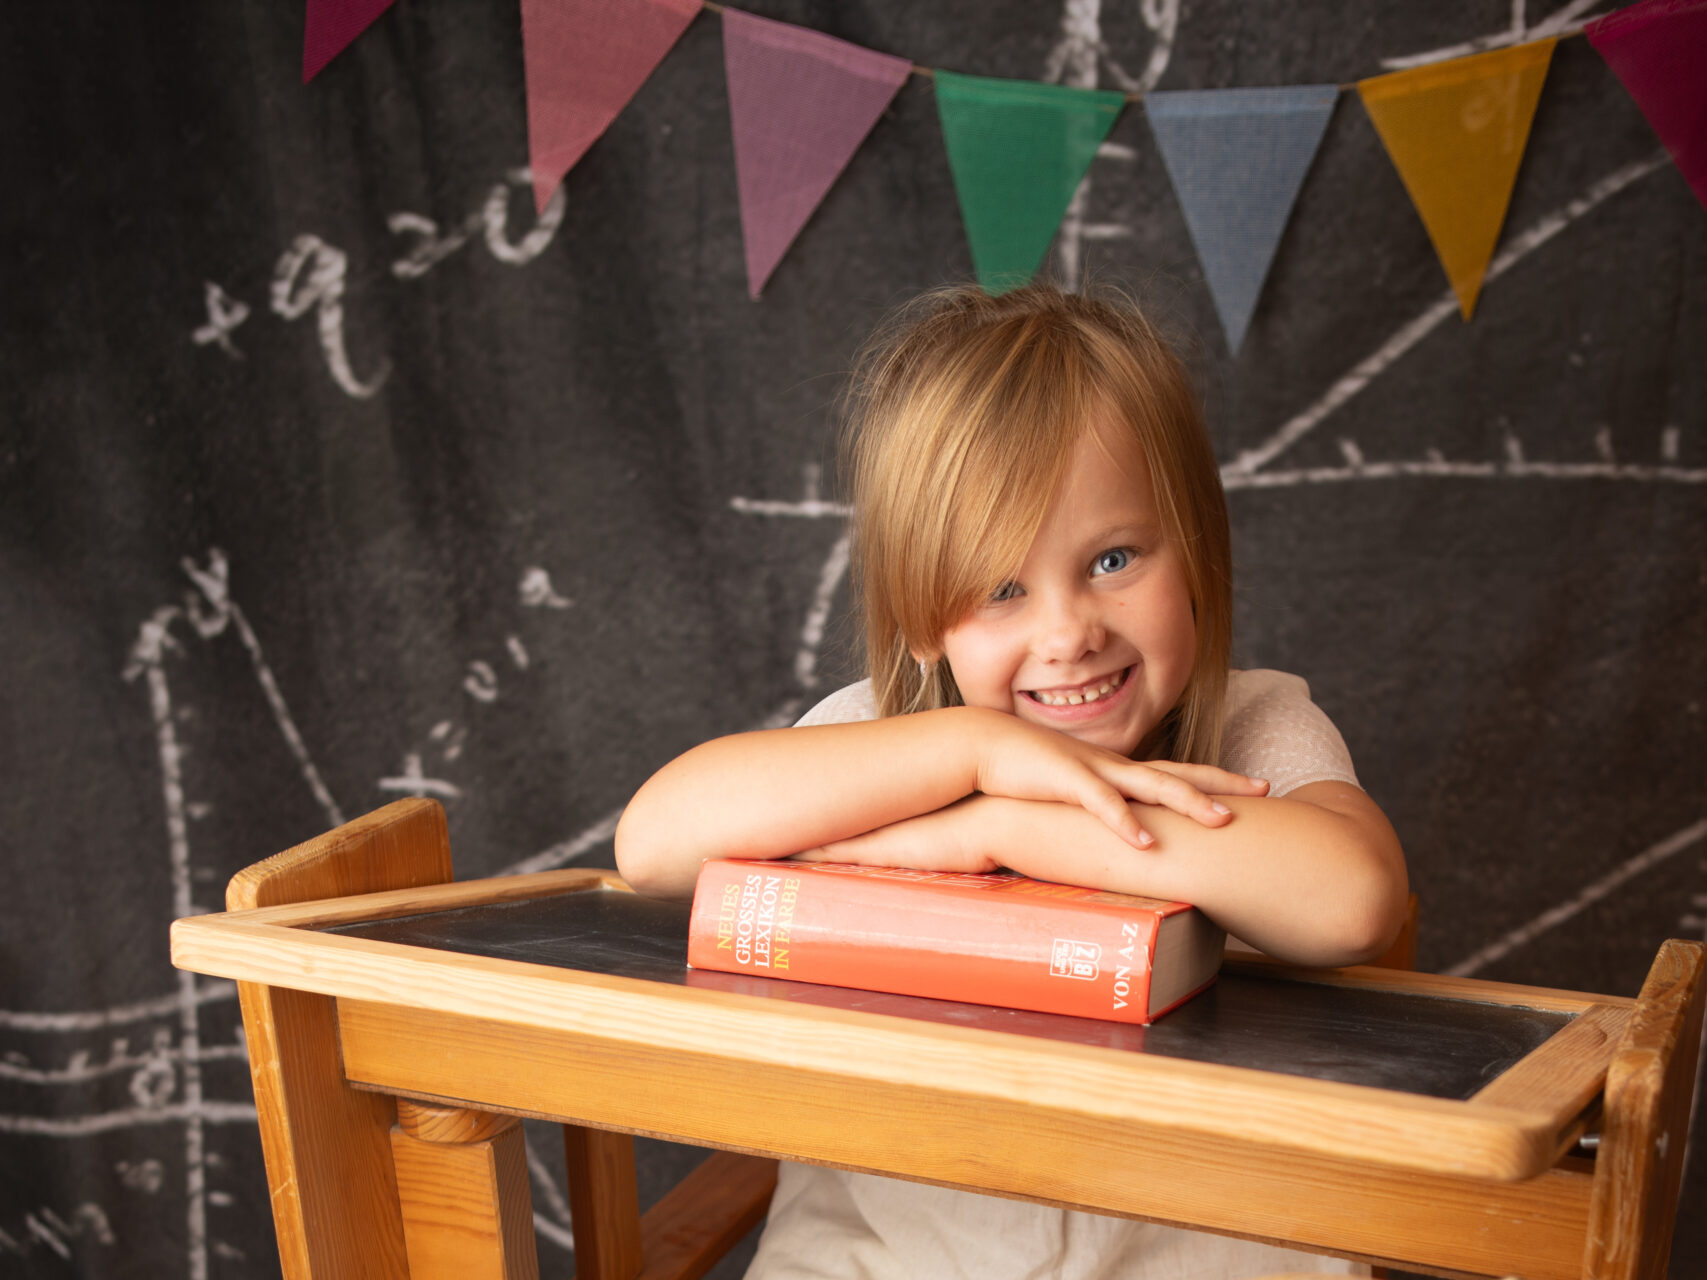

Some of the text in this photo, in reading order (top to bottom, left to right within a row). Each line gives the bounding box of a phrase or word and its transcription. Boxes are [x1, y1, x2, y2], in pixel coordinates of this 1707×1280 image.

[717, 883, 741, 952] NEUES
[736, 874, 763, 965] GROSSES
[755, 875, 782, 968] LEXIKON
[774, 877, 801, 971] IN FARBE
[1113, 923, 1139, 1011] VON A-Z
